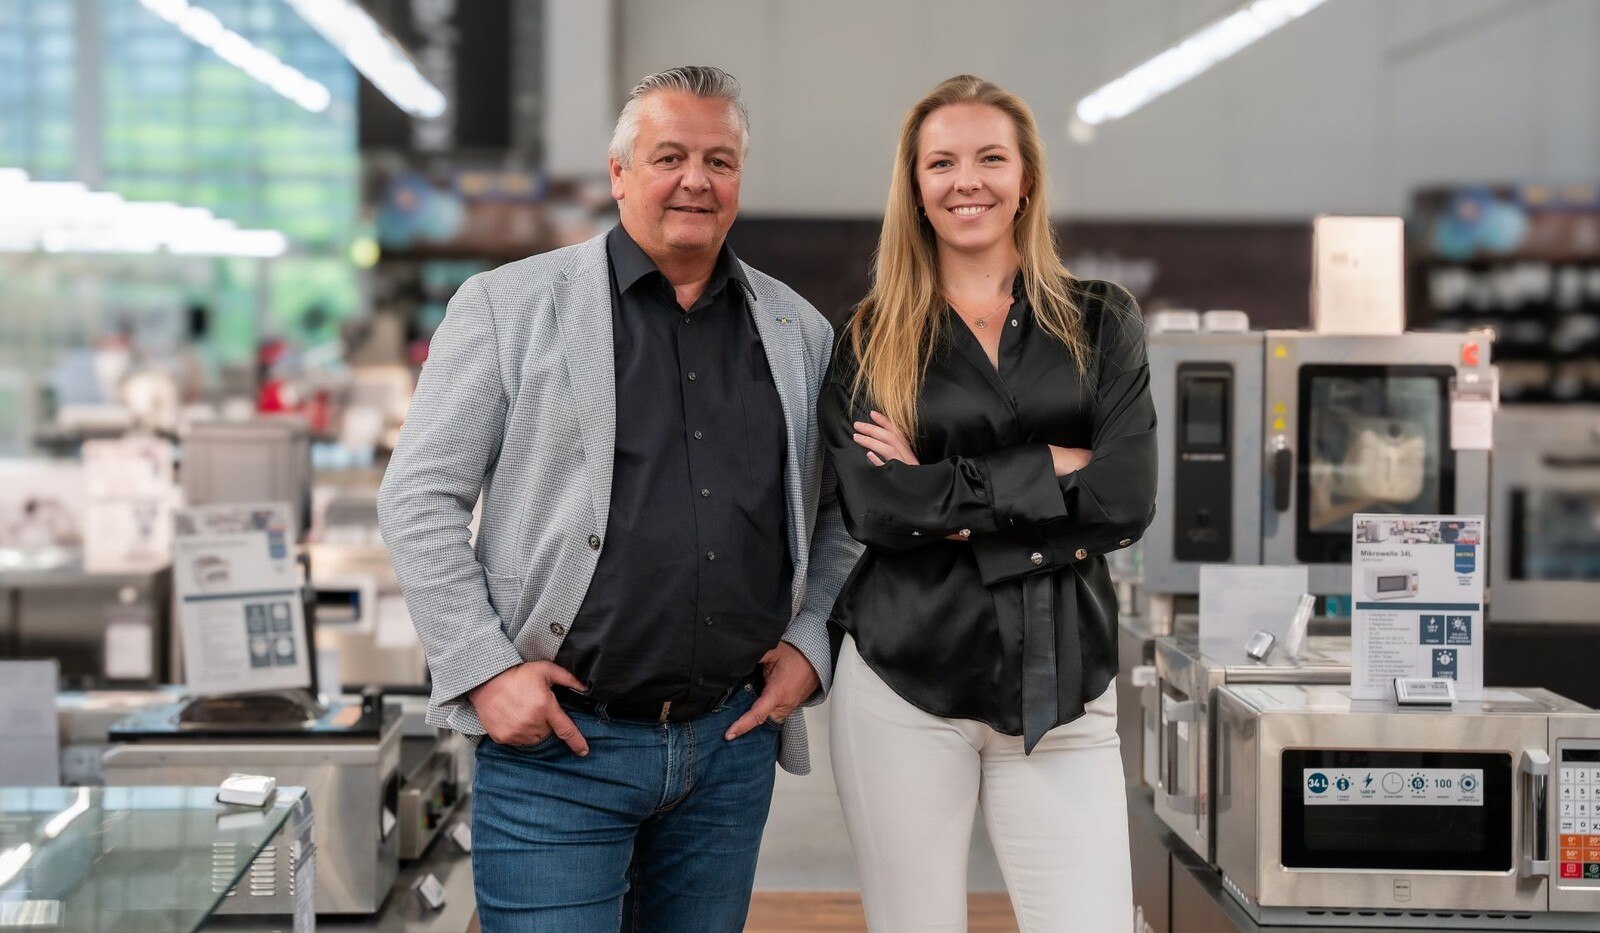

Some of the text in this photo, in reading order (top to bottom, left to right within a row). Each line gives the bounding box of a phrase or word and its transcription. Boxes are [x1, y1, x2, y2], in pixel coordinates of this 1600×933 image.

[1308, 778, 1328, 788] 34 L
[1435, 779, 1452, 788] 100
